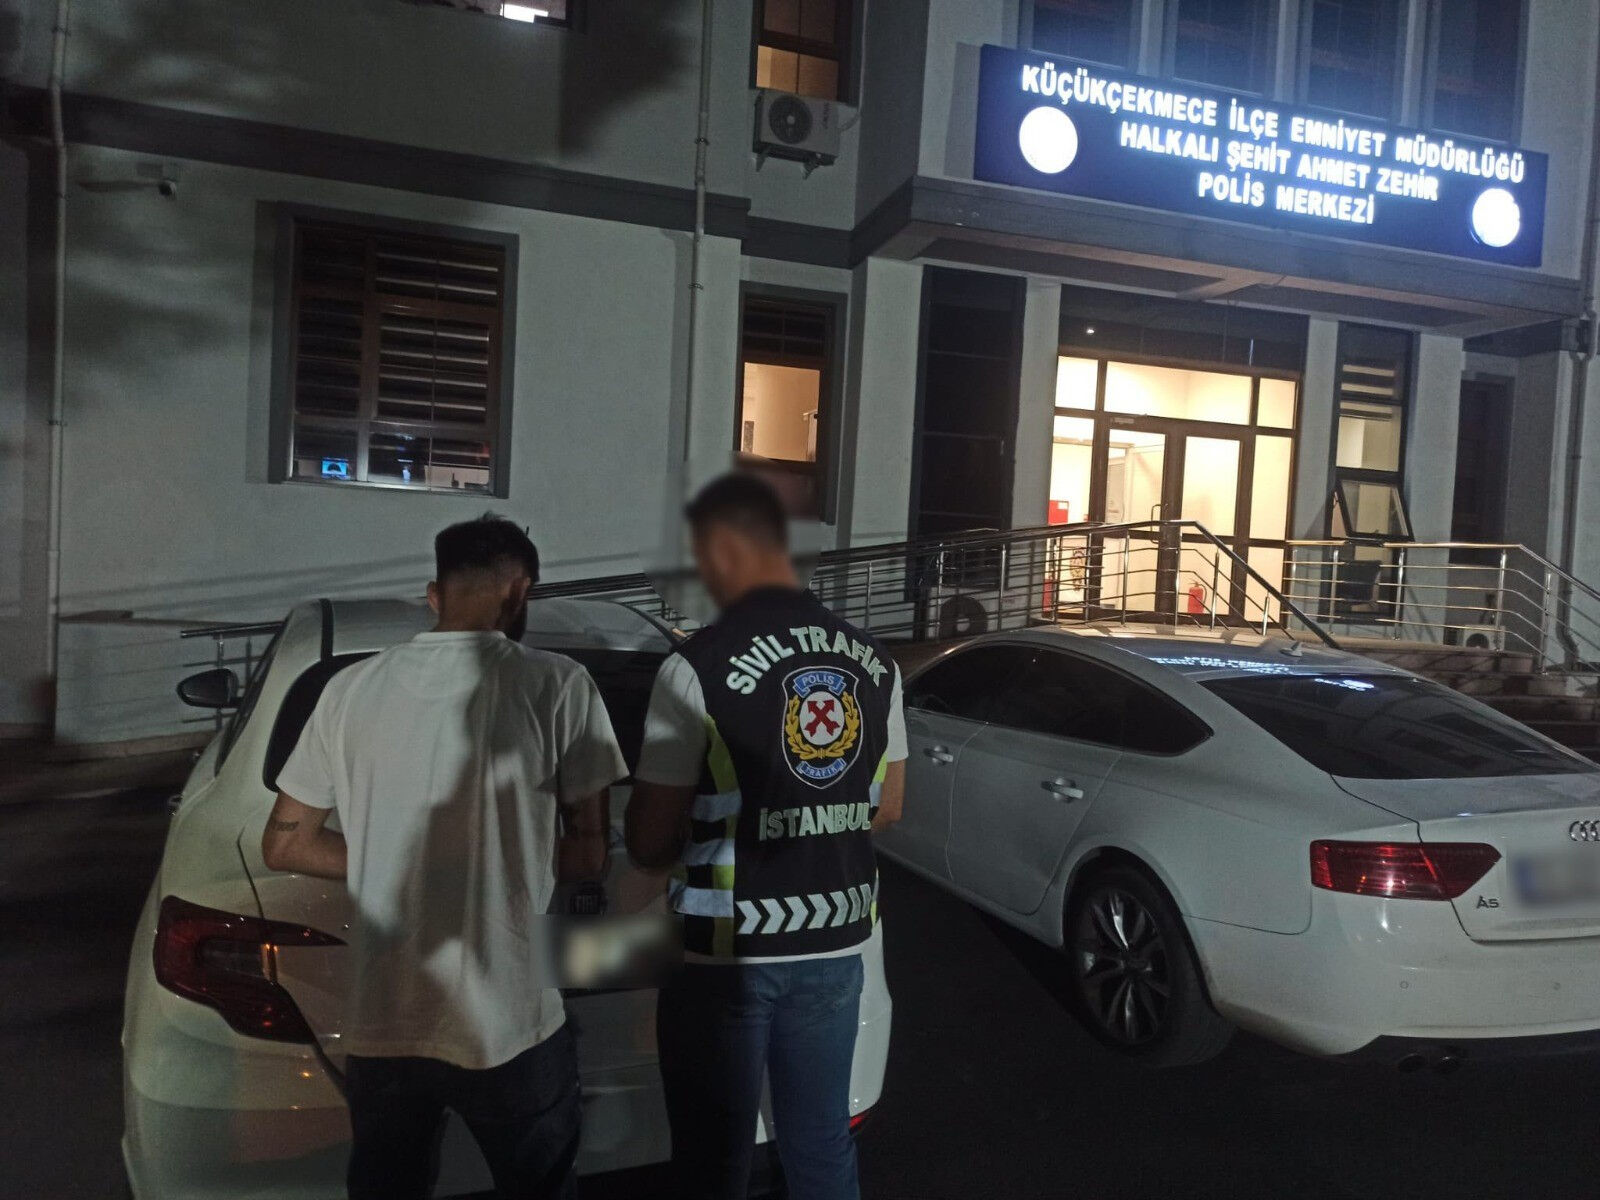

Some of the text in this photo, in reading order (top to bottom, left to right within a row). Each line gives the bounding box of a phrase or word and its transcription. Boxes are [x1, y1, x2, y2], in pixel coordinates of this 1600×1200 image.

[1021, 61, 1525, 183] KÜÇÜKÇEKMECE İLÇE EMNİYET MÜDÜRLÜĞÜ
[1120, 121, 1439, 201] HALKALI ŞEHİT AHMET ZEHİR
[1197, 172, 1375, 224] POLİS MERKEZİ
[726, 635, 795, 694] SİVİL
[759, 802, 871, 841] İSTANBUL
